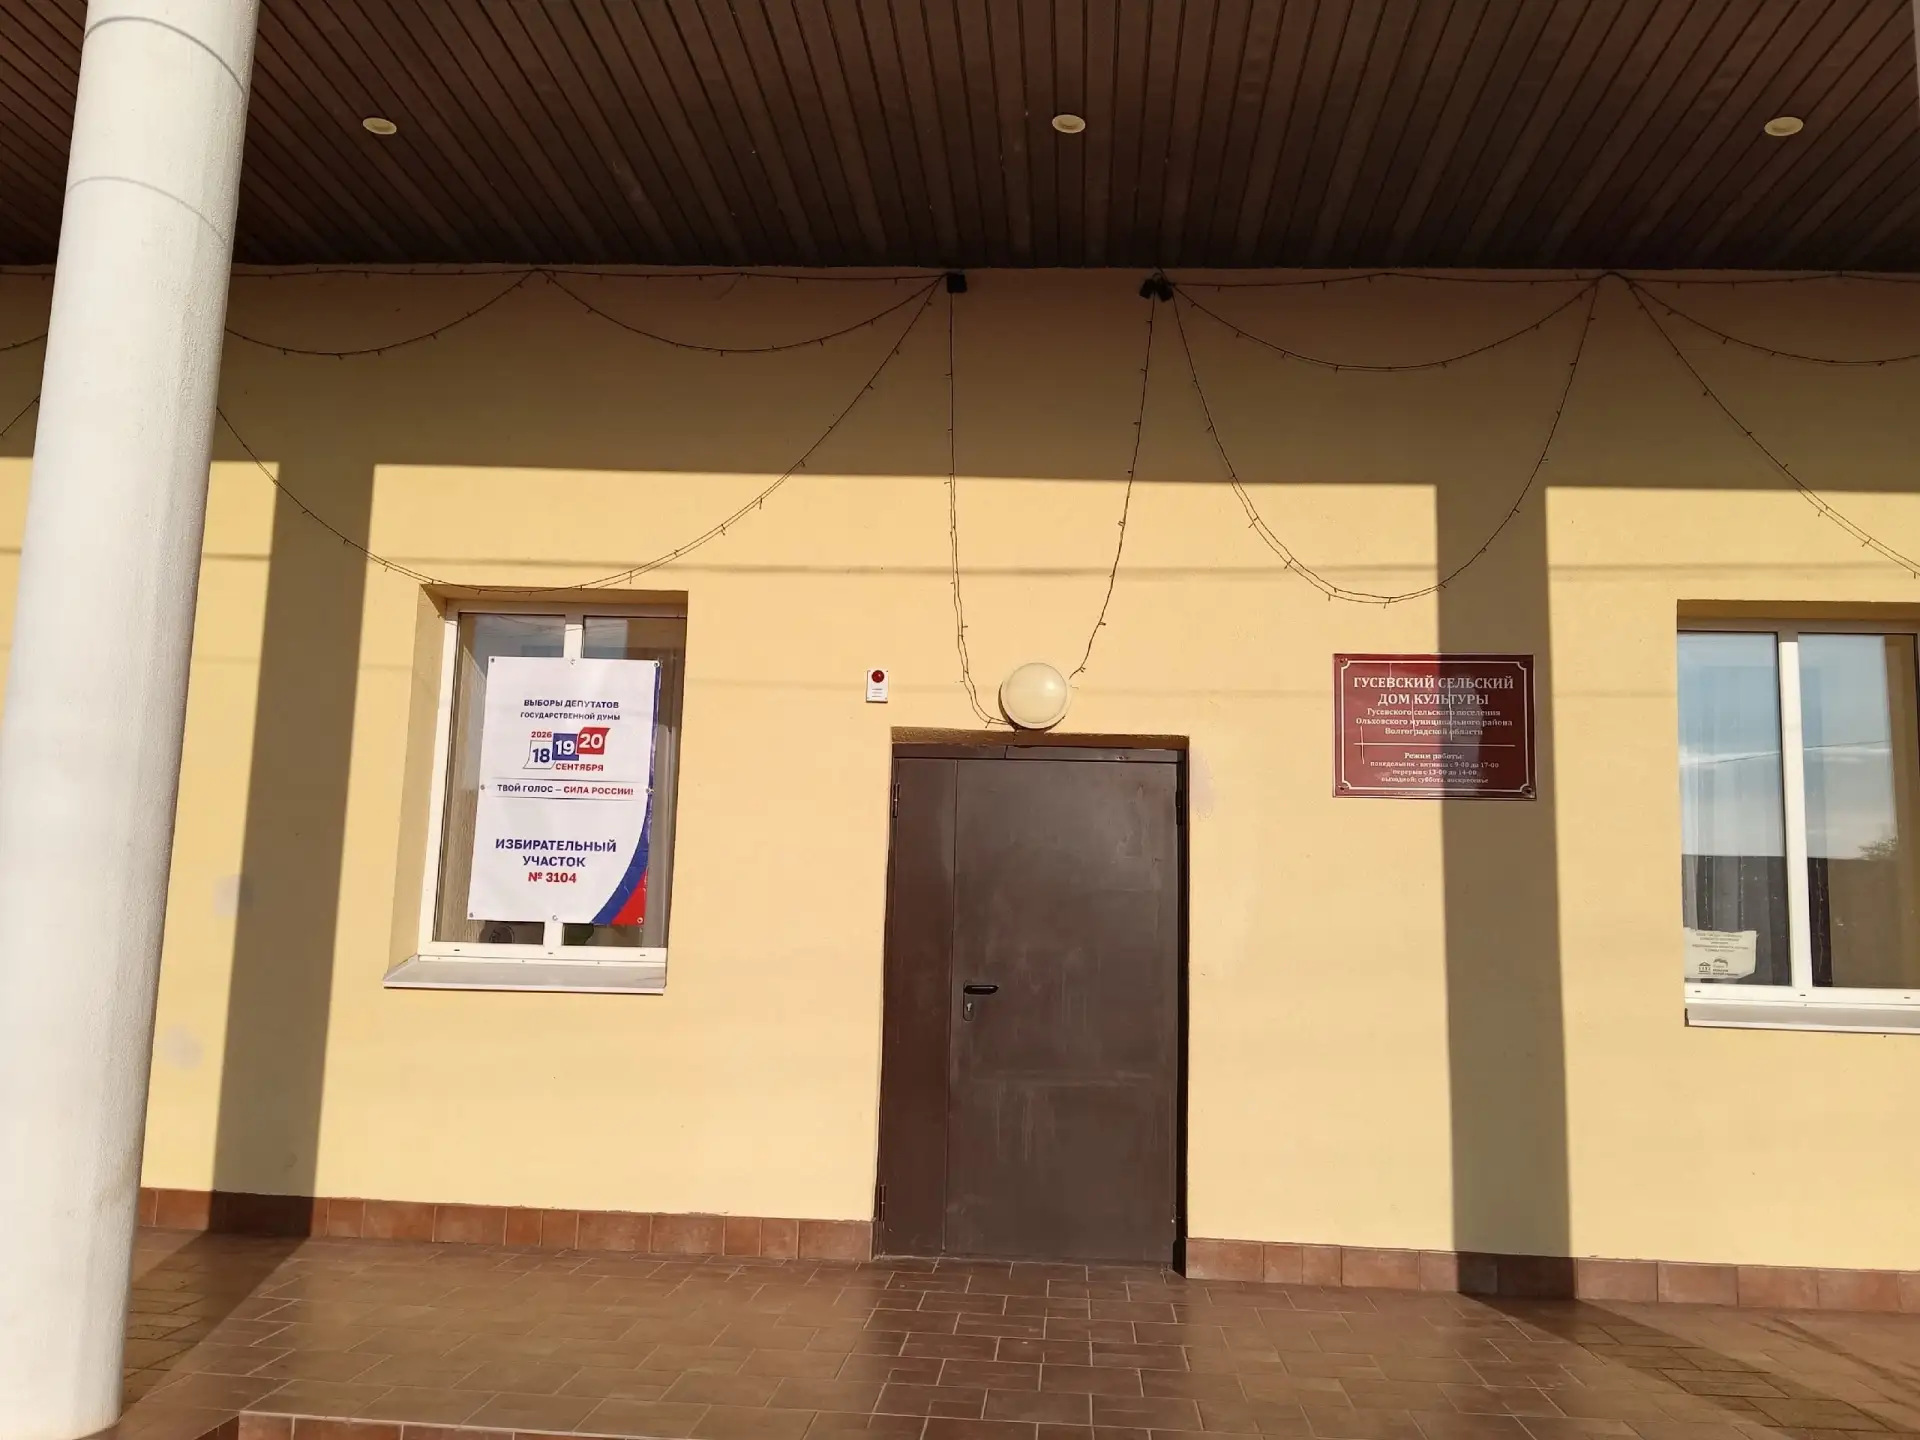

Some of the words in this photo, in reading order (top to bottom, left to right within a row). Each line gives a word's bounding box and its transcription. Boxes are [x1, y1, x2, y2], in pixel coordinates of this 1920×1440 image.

[1353, 674, 1435, 689] ГУСЕВСКИЙ
[1438, 675, 1514, 689] СЕЛЬСКИЙ
[523, 699, 563, 708] ВЫБОРЫ
[564, 700, 619, 709] ДЕПУТАТОВ
[1377, 693, 1411, 706] ДОМ
[1413, 693, 1489, 706] КУЛЬТУРЫ
[520, 711, 596, 721] ГОСУДАРСТВЕННОЙ
[596, 713, 621, 721] ДУМЫ
[1367, 707, 1412, 717] Гусевского
[1413, 708, 1455, 717] сельского
[1456, 709, 1501, 717] поселения
[1355, 717, 1408, 726] Ольховского
[1410, 718, 1480, 728] муниципального
[1482, 718, 1513, 727] района
[531, 731, 553, 739] 2026
[1385, 726, 1447, 736] Волгоградской
[1449, 727, 1484, 736] области
[532, 748, 551, 764] 18
[555, 740, 575, 756] 19
[578, 733, 604, 749] 20
[1404, 752, 1431, 760] Режим
[555, 763, 604, 772] СЕНТЯБРЯ
[497, 783, 522, 793] ТВОЙ
[522, 785, 553, 793] ГОЛОС
[563, 786, 590, 795] СИЛА
[591, 787, 634, 796] РОССИИ!
[495, 838, 617, 852] ИЗБИРАТЕЛЬНЫЙ
[522, 855, 586, 868] УЧАСТОК
[528, 872, 543, 882] №
[546, 872, 577, 883] 3104
